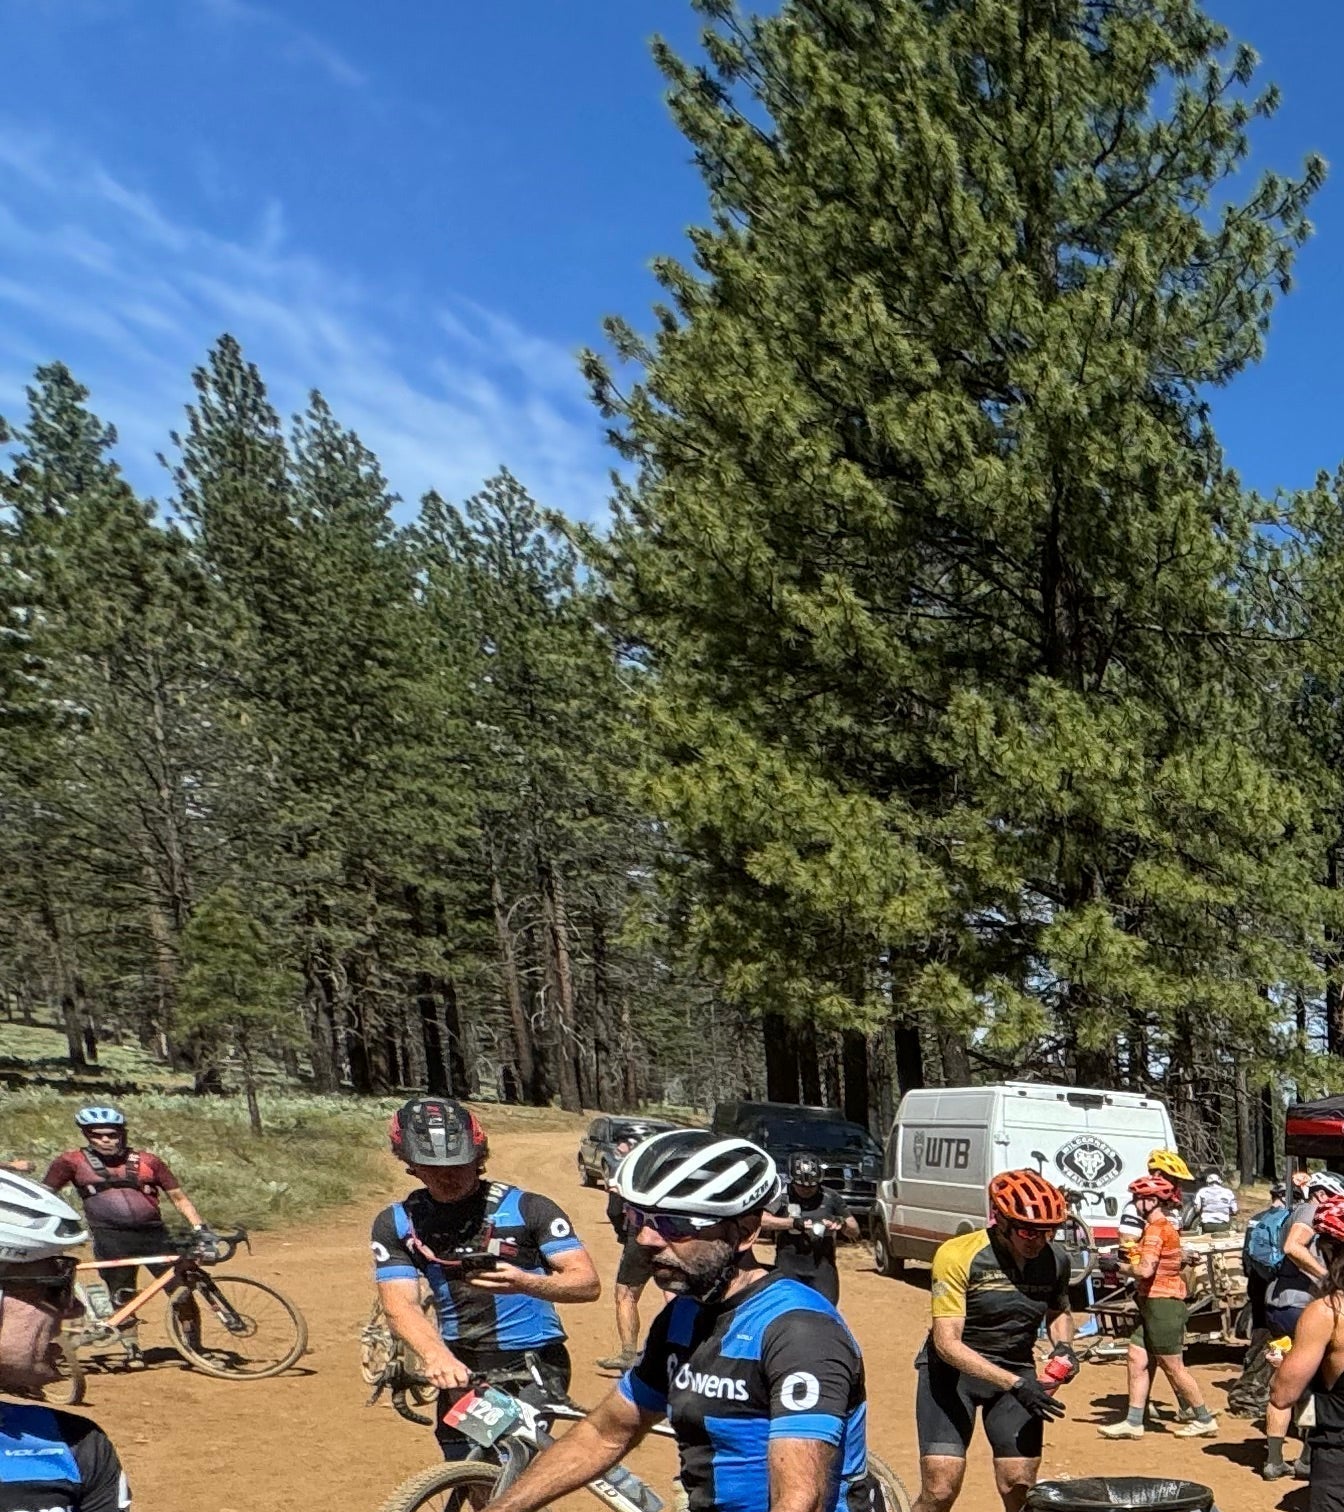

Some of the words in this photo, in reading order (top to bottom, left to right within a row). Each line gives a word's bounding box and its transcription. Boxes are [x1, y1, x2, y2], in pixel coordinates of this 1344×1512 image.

[925, 1137, 971, 1169] WTB
[741, 1180, 770, 1209] LAZER
[675, 1358, 750, 1401] Owens
